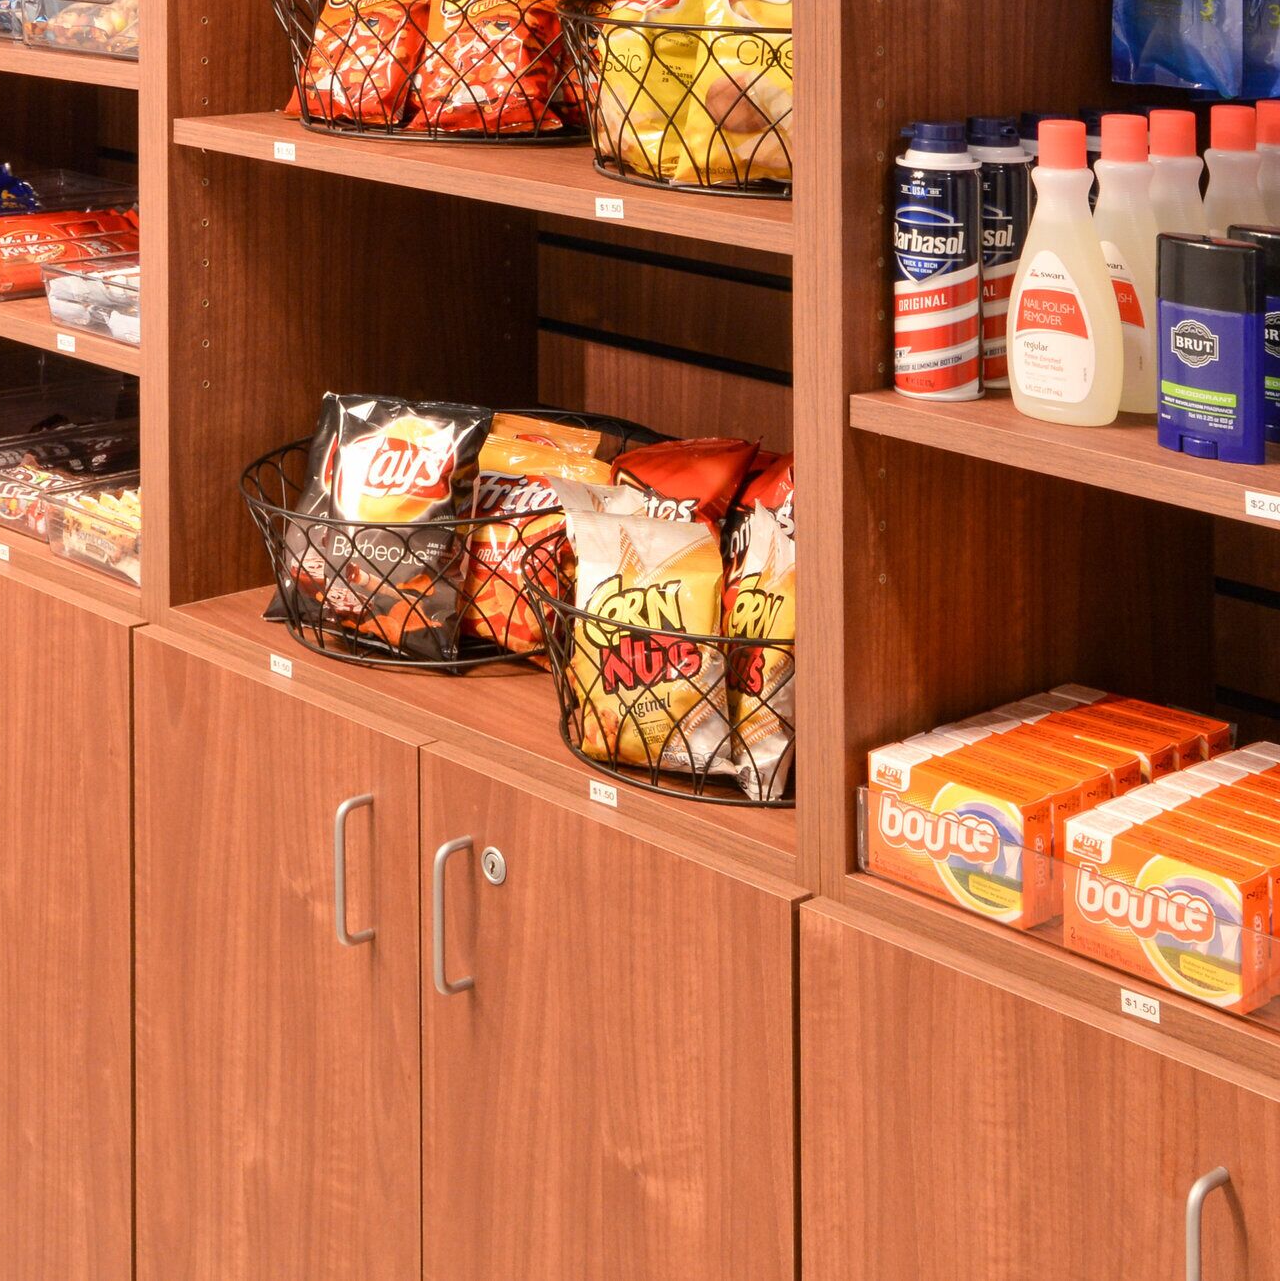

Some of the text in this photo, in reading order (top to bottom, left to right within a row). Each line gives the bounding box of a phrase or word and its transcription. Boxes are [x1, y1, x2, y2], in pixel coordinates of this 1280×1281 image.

[912, 187, 925, 195] USA
[600, 203, 622, 214] $1.50
[1040, 271, 1065, 280] swan
[898, 294, 948, 311] ORIGINAL
[1023, 298, 1075, 314] NAIL POLISH
[1023, 310, 1062, 325] REMOVER
[1024, 341, 1048, 352] regular
[1175, 335, 1213, 353] BRUT
[1175, 388, 1233, 403] DEODORANT
[332, 536, 428, 567] Barbecue
[584, 574, 683, 647] CORN
[599, 630, 702, 693] NUTS
[592, 786, 615, 802] $1.50
[879, 793, 1001, 855] bounce
[1077, 866, 1214, 935] bounce
[1124, 997, 1157, 1016] $1.50
